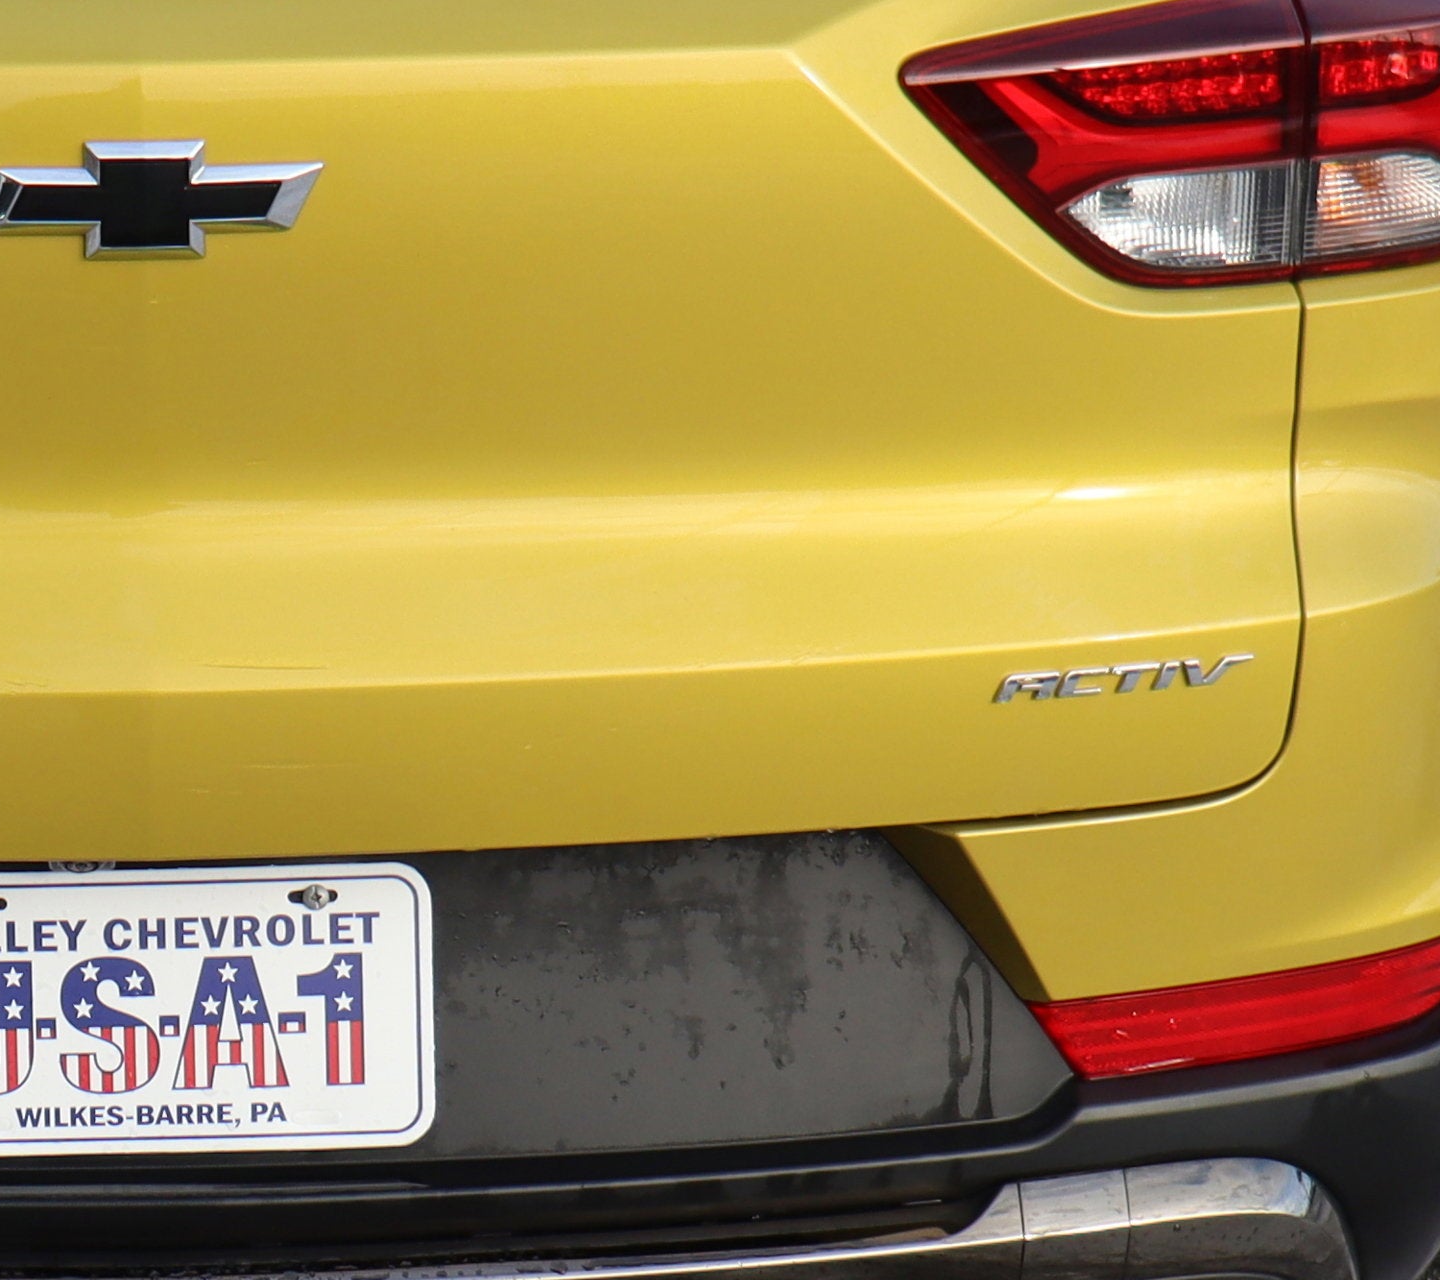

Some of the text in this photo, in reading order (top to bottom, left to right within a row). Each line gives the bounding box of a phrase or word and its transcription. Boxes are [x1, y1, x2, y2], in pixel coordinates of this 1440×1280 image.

[991, 653, 1254, 703] ACTIV
[103, 911, 381, 951] CHEVROLET
[15, 1102, 287, 1130] WILKES-BARRE, PA
